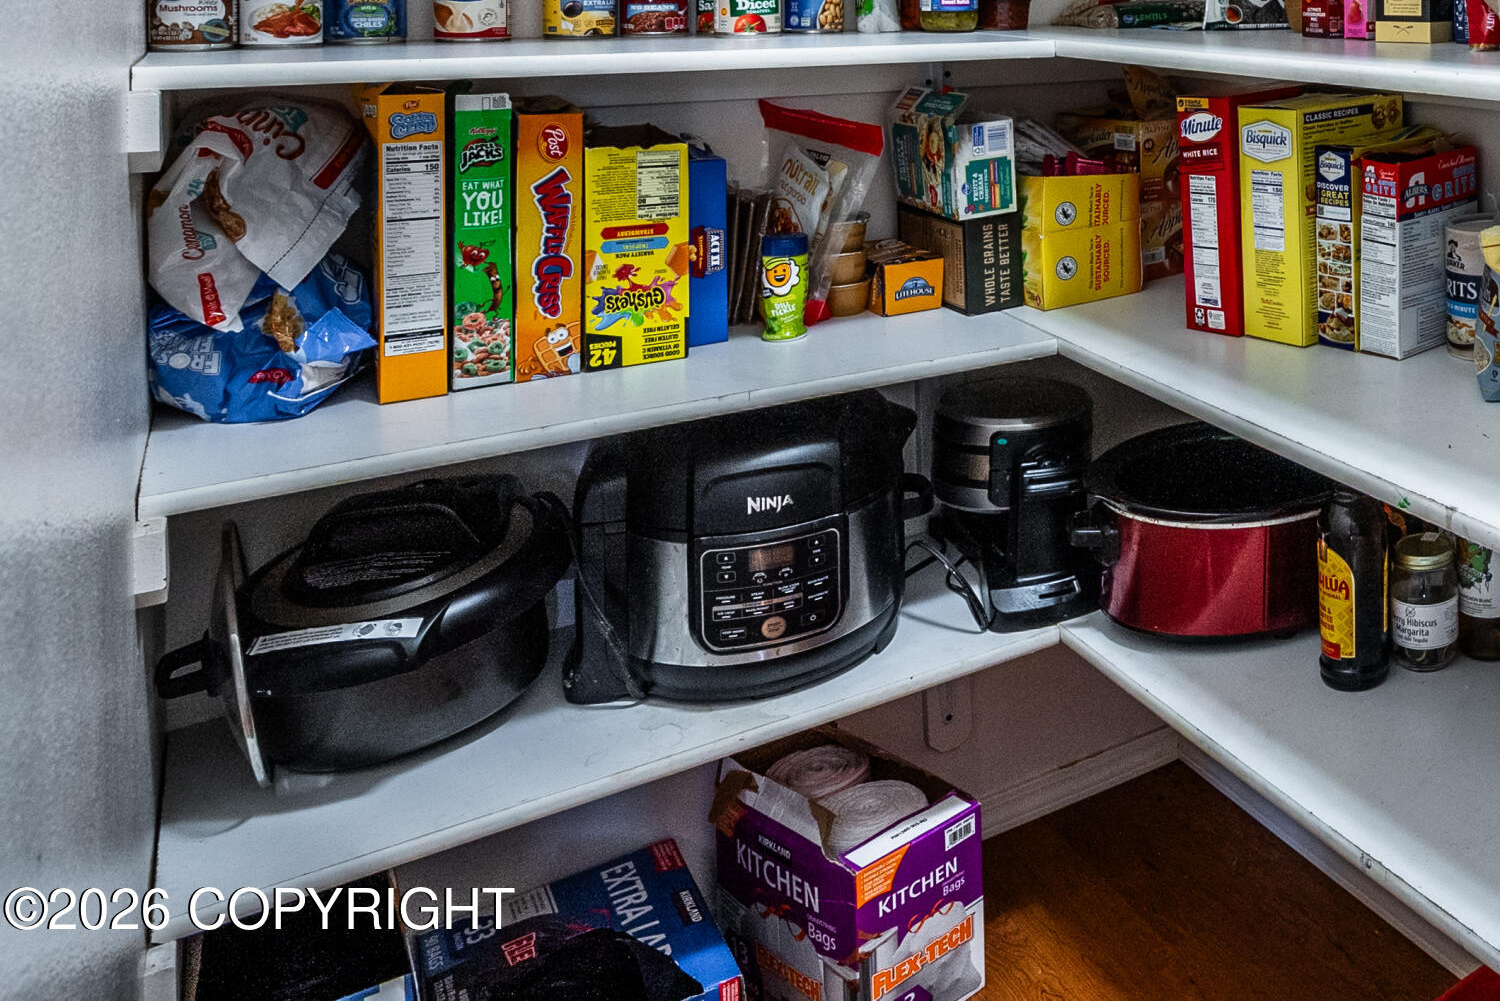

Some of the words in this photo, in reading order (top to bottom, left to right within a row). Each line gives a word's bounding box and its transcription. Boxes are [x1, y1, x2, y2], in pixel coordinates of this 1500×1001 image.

[160, 4, 218, 13] Mushrooms
[1305, 111, 1332, 122] CLASSIC
[1334, 108, 1358, 117] RECIPES
[1181, 117, 1222, 136] Minute
[545, 128, 564, 157] Post
[1246, 130, 1287, 149] Bisquick
[460, 148, 504, 173] JACKS
[1183, 150, 1201, 158] WHITE
[1202, 148, 1218, 156] RICE
[425, 163, 439, 171] 150
[1320, 160, 1345, 171] Bisquick
[462, 181, 478, 191] EAT
[482, 180, 504, 189] WHAT
[1317, 182, 1349, 191] DISCOVER
[1321, 190, 1349, 199] GREAT
[1366, 183, 1396, 196] GRITS
[1404, 185, 1428, 199] ALBERS
[1432, 174, 1476, 201] GRITS
[462, 190, 503, 210] YOU
[1321, 197, 1349, 207] RECIPES
[464, 210, 503, 226] LIKE!
[531, 166, 572, 256] WAFFLE
[617, 229, 654, 237] STRAWBERRY
[983, 224, 994, 264] GRAINS
[999, 223, 1010, 265] BETTER
[895, 287, 933, 300] LITEHOUSE
[984, 267, 995, 306] WHOLE
[1000, 268, 1011, 303] TASTE
[606, 287, 665, 313] Gushers
[774, 302, 790, 310] DILL
[589, 349, 616, 367] 42
[643, 352, 664, 360] SOURCE
[747, 494, 794, 514] NINJA
[1407, 618, 1437, 628] Hibiscus
[758, 835, 791, 860] KIRKLAND
[736, 838, 820, 914] KITCHEN
[600, 860, 654, 927] EXTRA
[878, 856, 958, 918] KITCHEN
[943, 876, 965, 897] Bags
[679, 890, 703, 923] KIRKLAND
[807, 922, 836, 951] Bags
[872, 914, 974, 1001] FLEX-TECH
